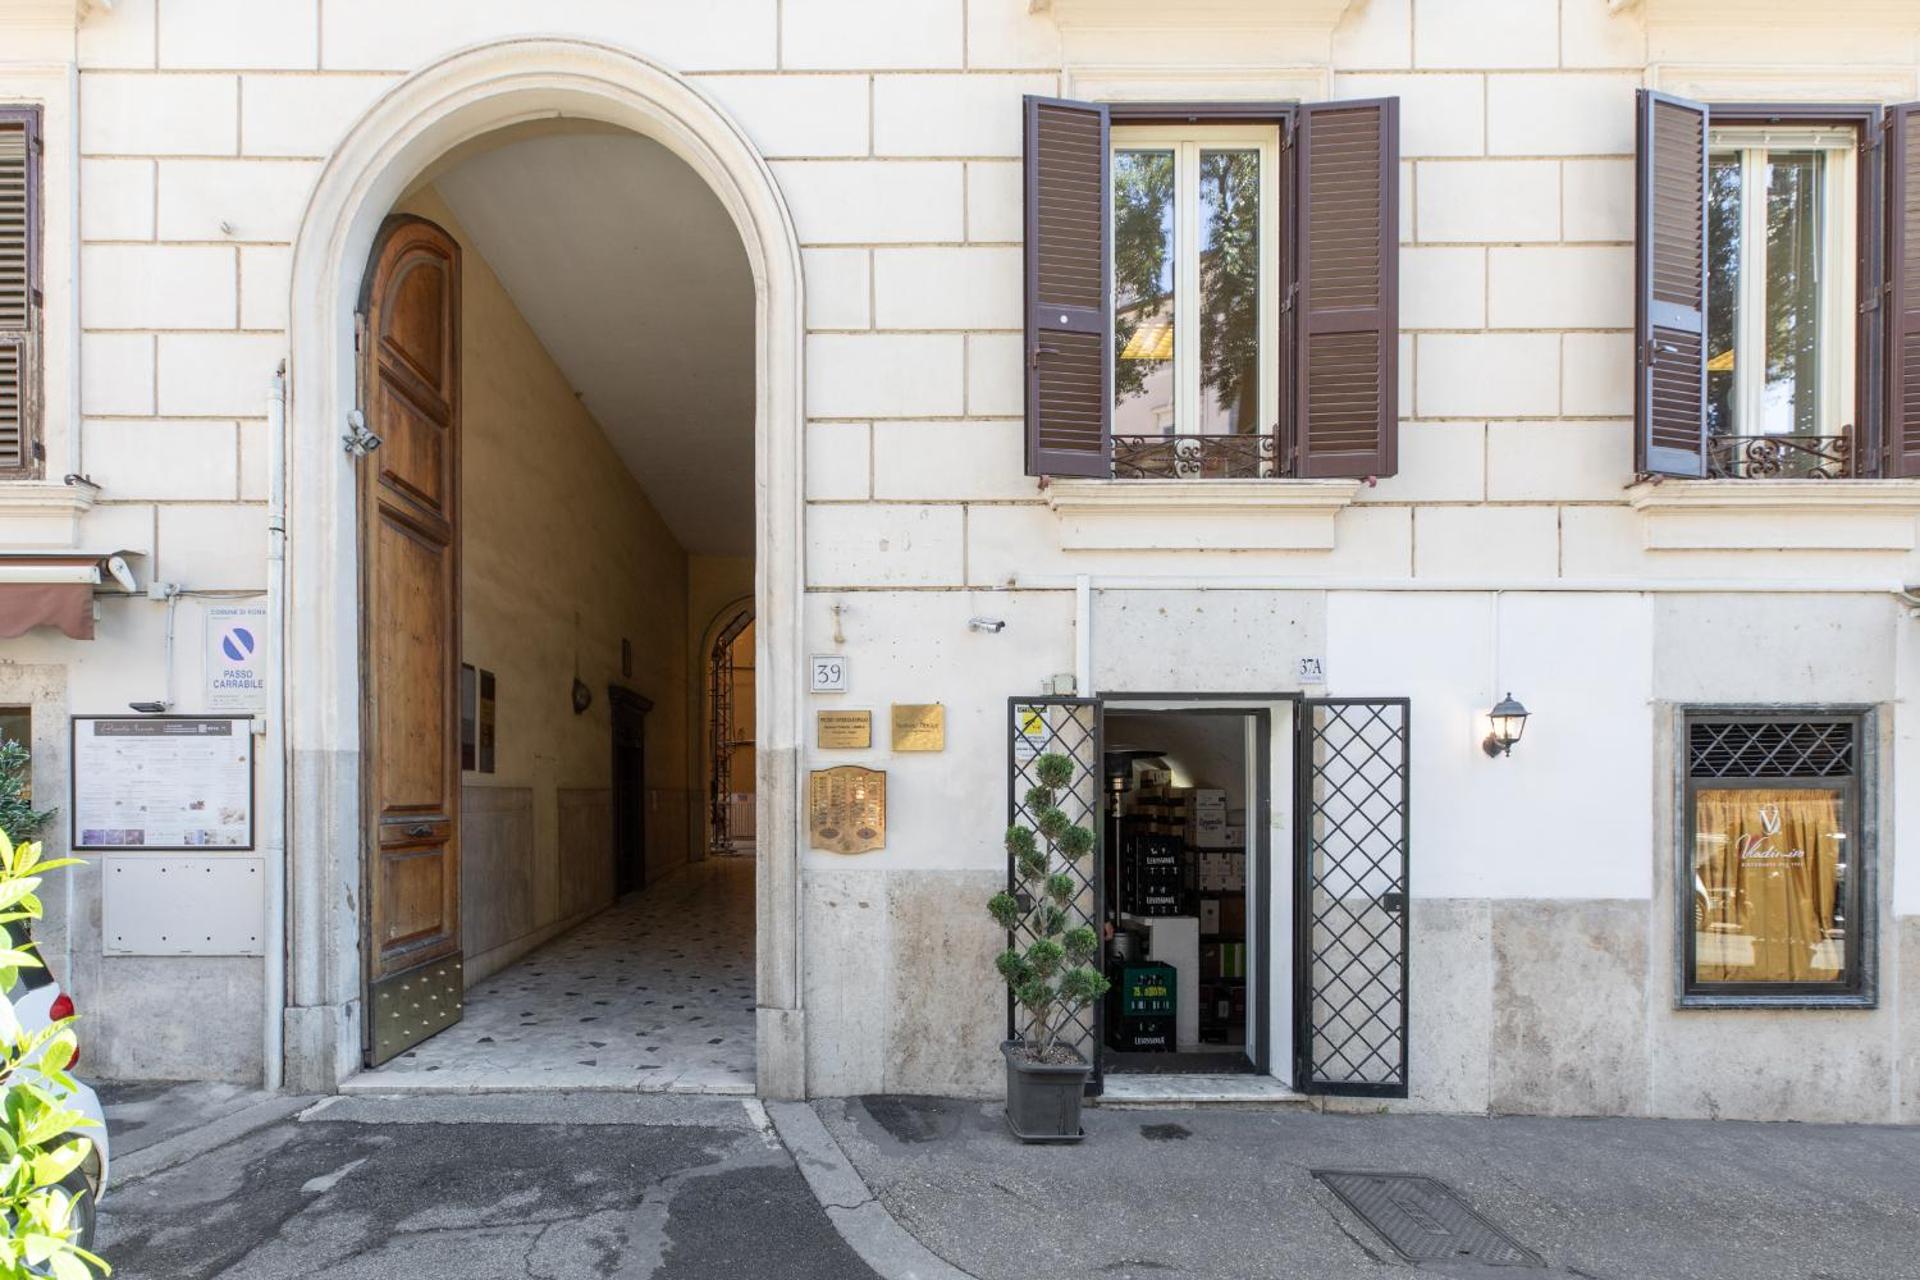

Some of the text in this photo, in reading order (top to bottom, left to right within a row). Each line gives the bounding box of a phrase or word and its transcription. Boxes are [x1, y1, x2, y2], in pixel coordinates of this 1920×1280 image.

[1300, 658, 1322, 675] 37A
[223, 669, 253, 679] PASSO
[817, 663, 841, 684] 39
[213, 679, 264, 689] CARRABILE
